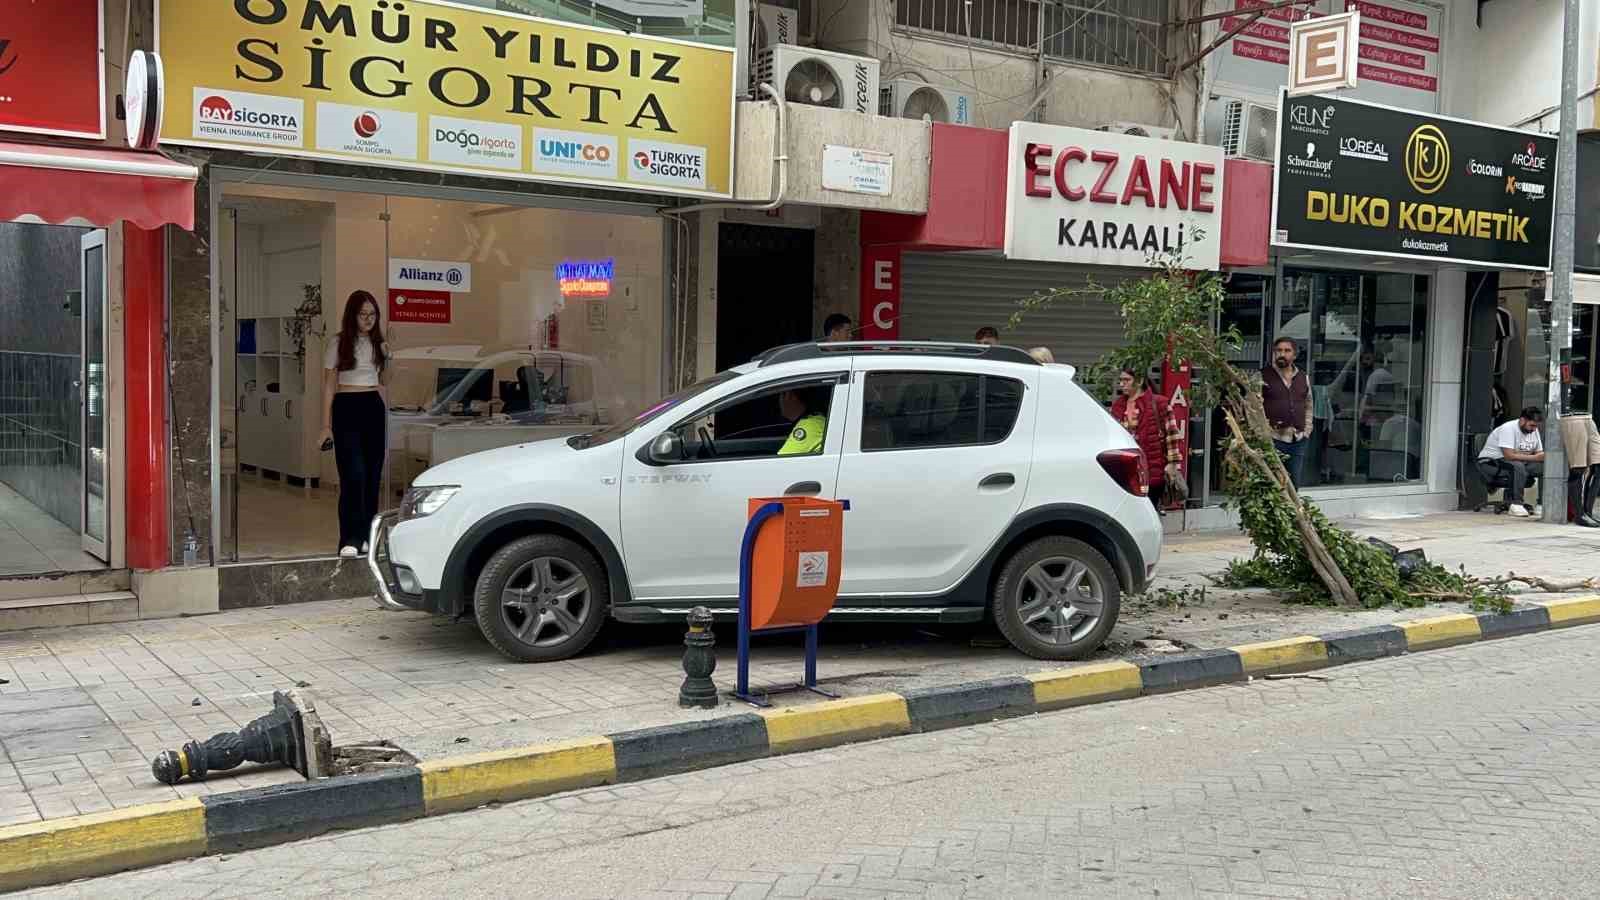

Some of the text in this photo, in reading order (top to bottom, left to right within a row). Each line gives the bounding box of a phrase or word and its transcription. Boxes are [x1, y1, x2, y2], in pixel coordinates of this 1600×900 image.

[483, 26, 681, 84] YILDIZ
[1305, 32, 1337, 78] E
[235, 37, 678, 134] SİGORTA
[202, 106, 297, 128] RAY SİGORTA
[1290, 103, 1331, 129] KEUNE
[199, 125, 298, 142] VIENNA INSURANCE GROUP
[650, 150, 701, 167] TÜRKİYE
[1287, 154, 1334, 173] Schwarzkopf
[1512, 153, 1546, 169] ARCADE
[650, 162, 701, 180] SİGORTA
[1024, 142, 1216, 214] ECZANE
[1306, 189, 1530, 244] DUKO KOZMETİK
[1058, 217, 1185, 254] KARAALİ
[1402, 237, 1449, 252] dukokozmetik
[399, 267, 444, 282] Allianz
